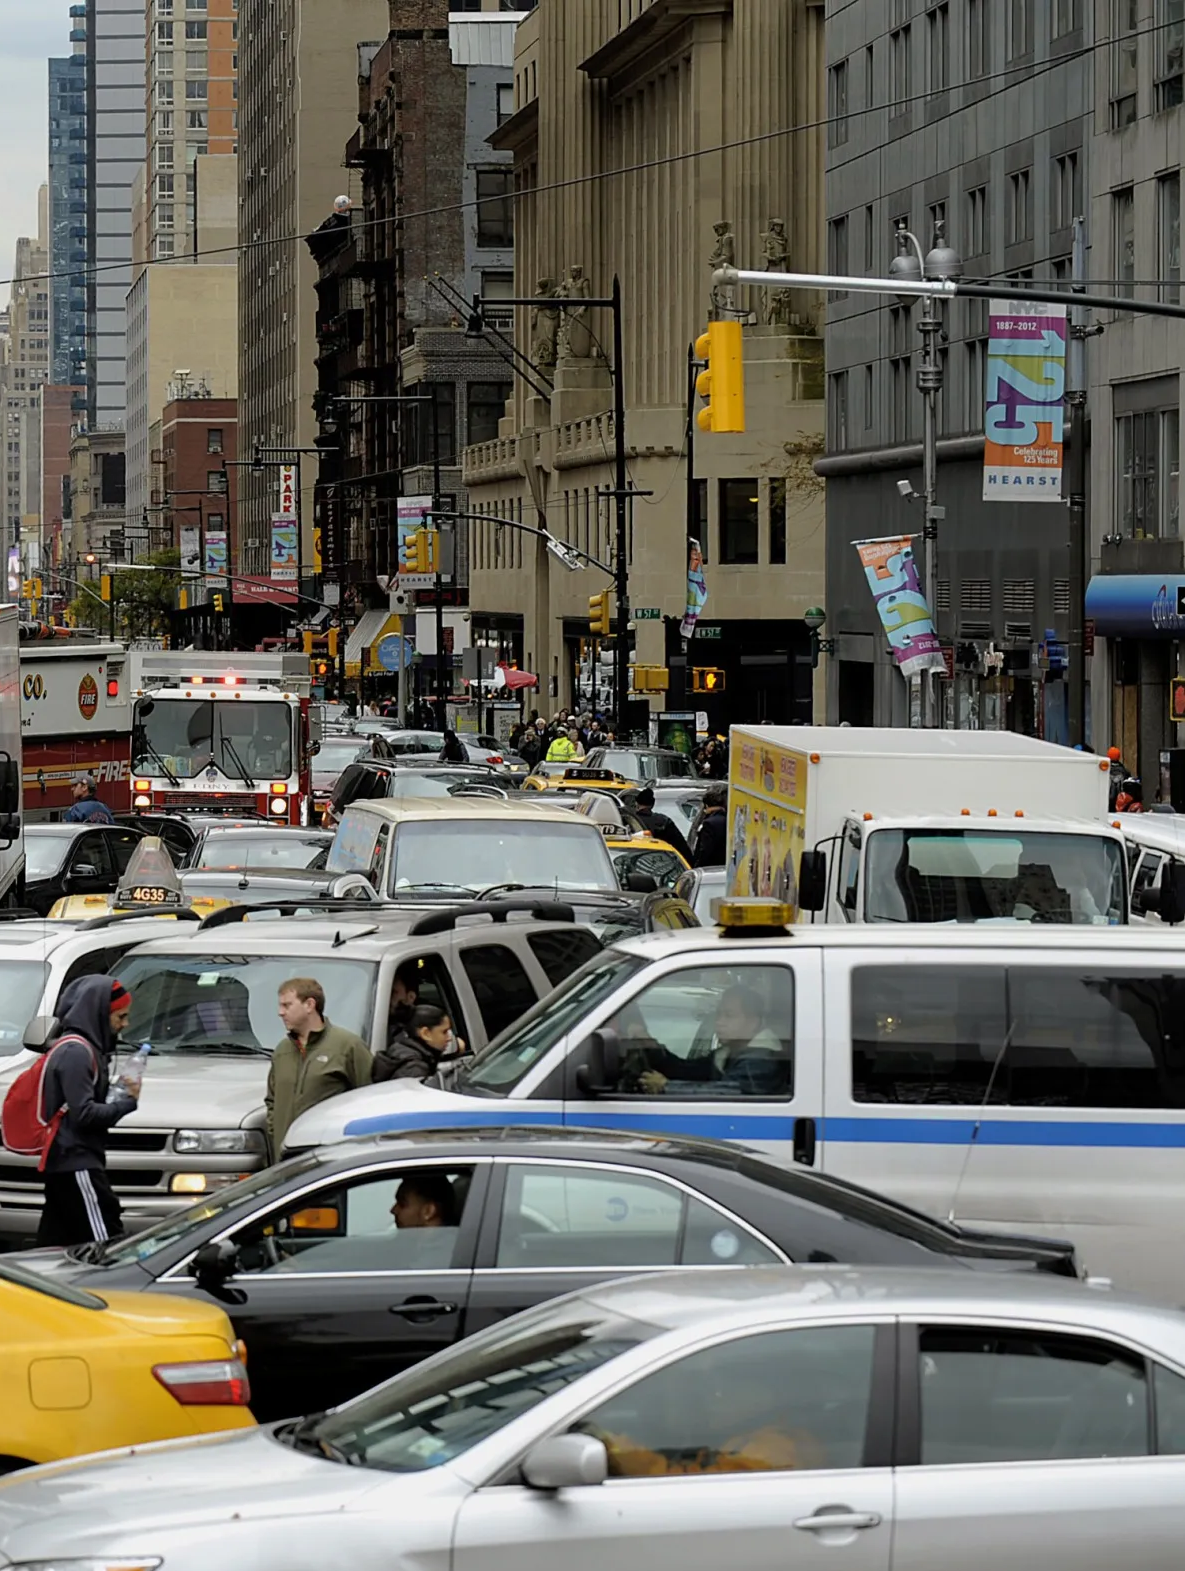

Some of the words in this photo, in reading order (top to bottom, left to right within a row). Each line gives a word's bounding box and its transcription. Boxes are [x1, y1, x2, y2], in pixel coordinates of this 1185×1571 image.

[1009, 302, 1047, 315] NYC
[985, 330, 1065, 446] 125
[1014, 446, 1058, 457] Celebrating
[1023, 455, 1035, 464] 125
[1036, 456, 1058, 465] Years
[988, 475, 1058, 486] HEARST
[283, 474, 292, 512] PARK
[637, 610, 642, 618] W
[644, 609, 652, 618] 57
[23, 673, 47, 701] CO.
[80, 694, 96, 705] FIRE
[97, 760, 129, 783] FIRE
[133, 887, 164, 901] 4G35
